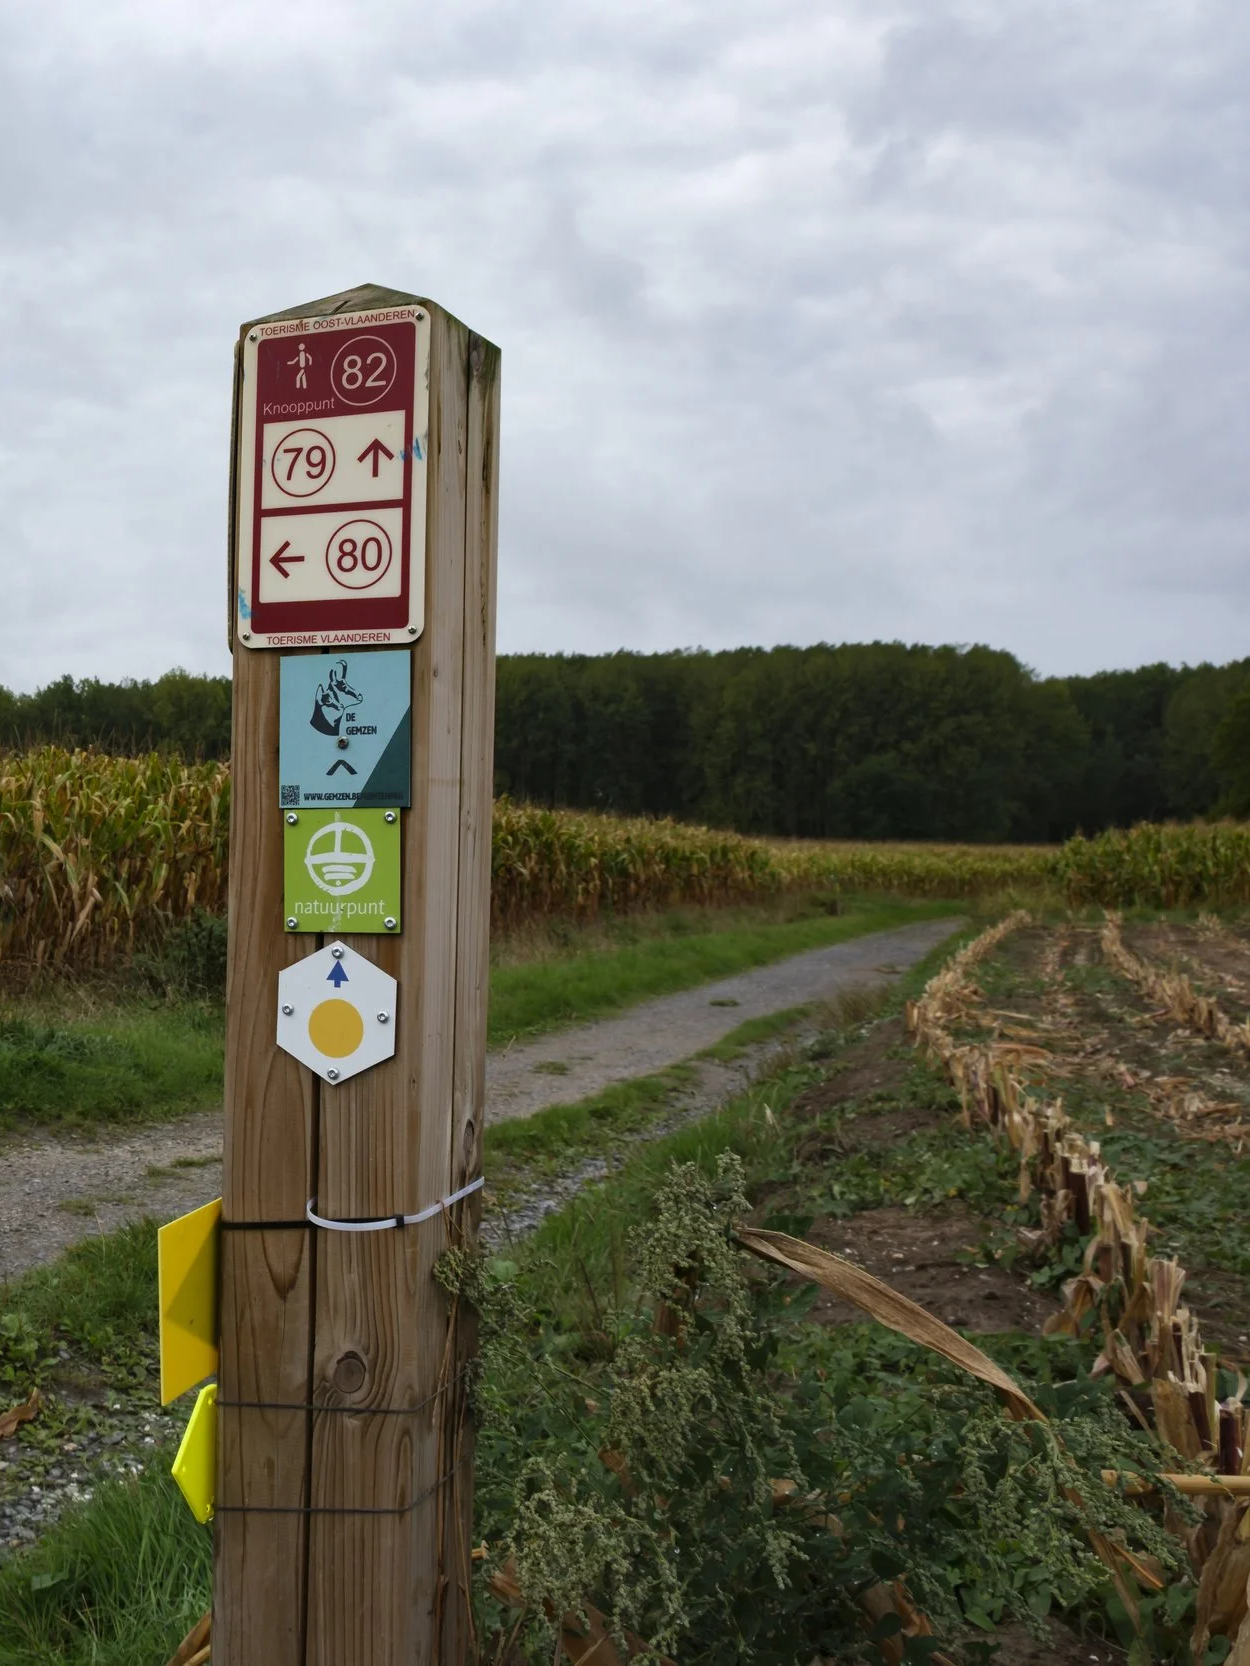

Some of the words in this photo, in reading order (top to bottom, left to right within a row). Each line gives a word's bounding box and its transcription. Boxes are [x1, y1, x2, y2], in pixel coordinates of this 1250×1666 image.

[259, 319, 311, 337] TOERISME
[313, 309, 415, 330] OOST-VLAANDEREN
[341, 352, 387, 389] 82
[263, 398, 335, 416] Knooppunt
[283, 445, 327, 481] 79
[336, 537, 382, 572] 80
[266, 634, 318, 645] TOERISME
[321, 632, 391, 644] VLAANDEREN
[345, 713, 356, 722] DE
[345, 725, 377, 735] GEMZEN
[294, 899, 385, 919] natuurpunt
